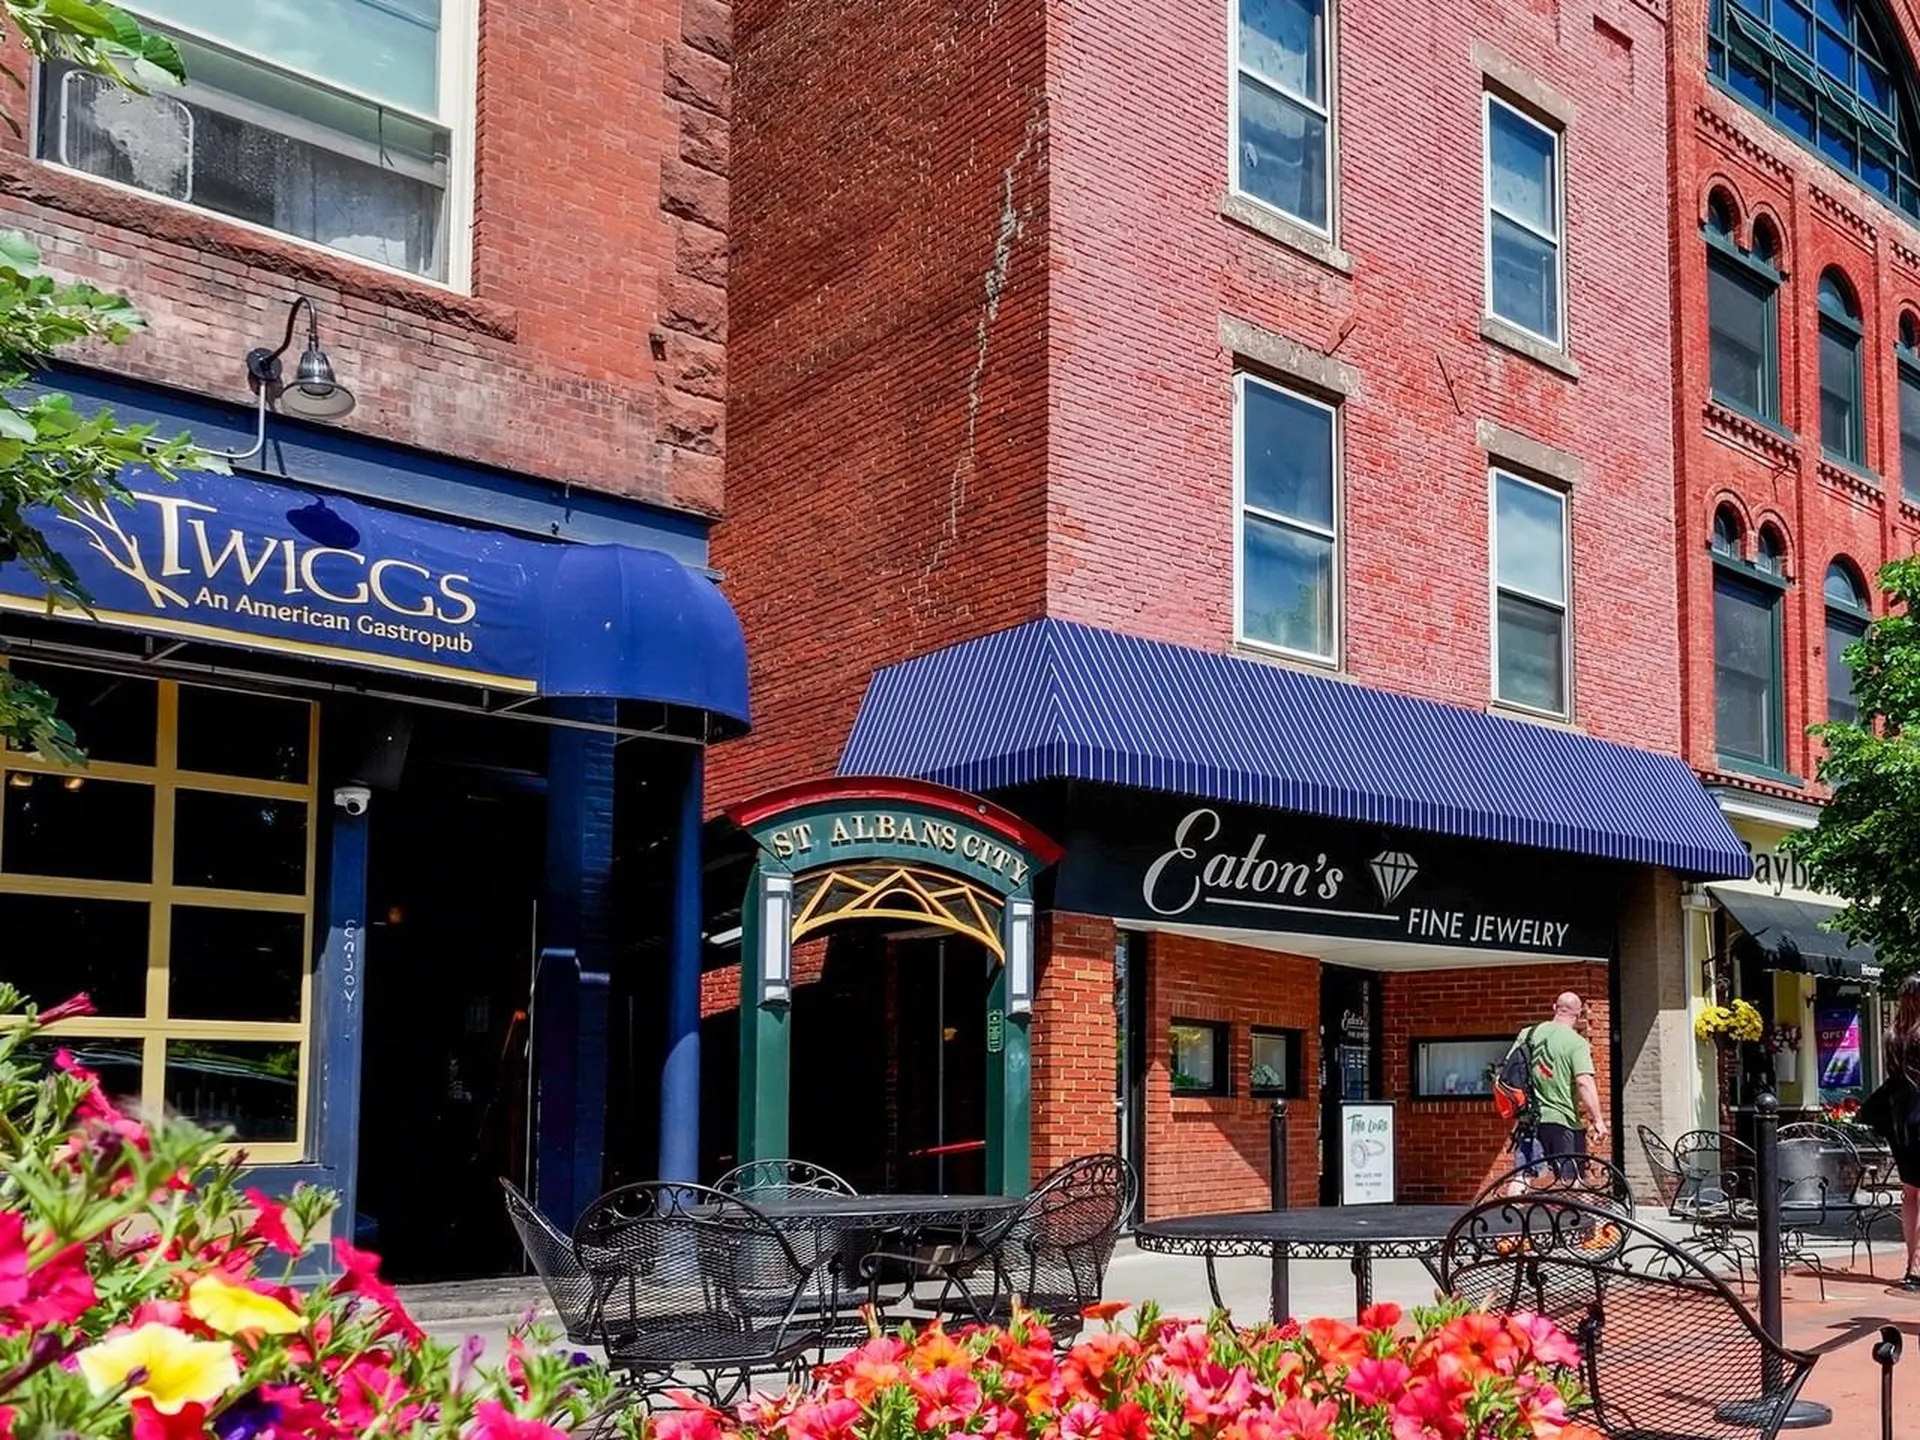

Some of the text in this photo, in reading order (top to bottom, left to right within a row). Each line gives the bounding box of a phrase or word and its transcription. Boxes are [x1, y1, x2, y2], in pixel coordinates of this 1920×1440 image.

[131, 491, 477, 625] TWIGGS
[195, 586, 474, 653] An American Gastropub
[772, 814, 1030, 887] ST ALBANS CITY
[1142, 808, 1345, 917] Eaton's
[1407, 908, 1570, 949] FINE JEWELRY
